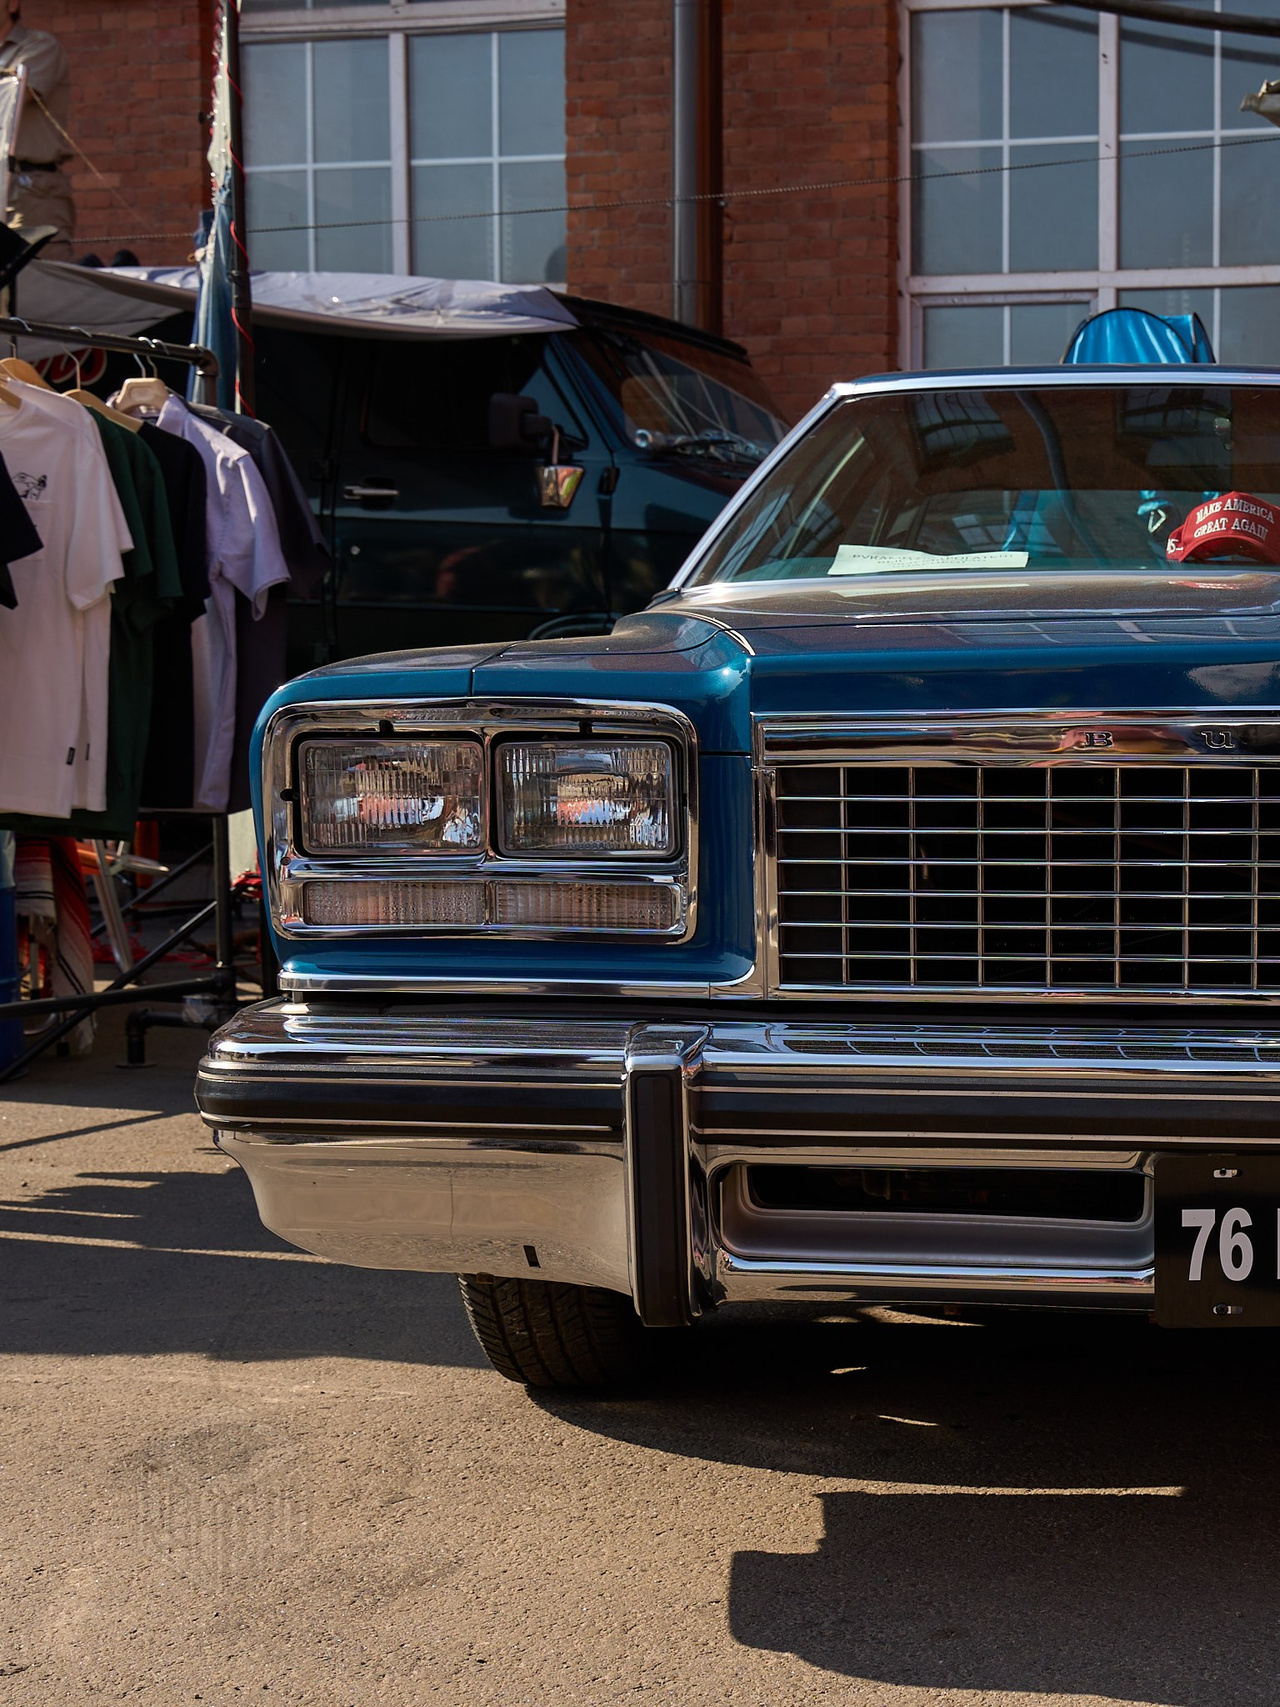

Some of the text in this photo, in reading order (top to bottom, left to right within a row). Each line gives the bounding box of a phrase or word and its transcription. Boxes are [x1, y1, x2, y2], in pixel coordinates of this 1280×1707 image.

[1195, 498, 1275, 525] MAKE AMERICA
[1193, 517, 1269, 541] GREAT AGAIN
[1181, 1207, 1254, 1282] 76
